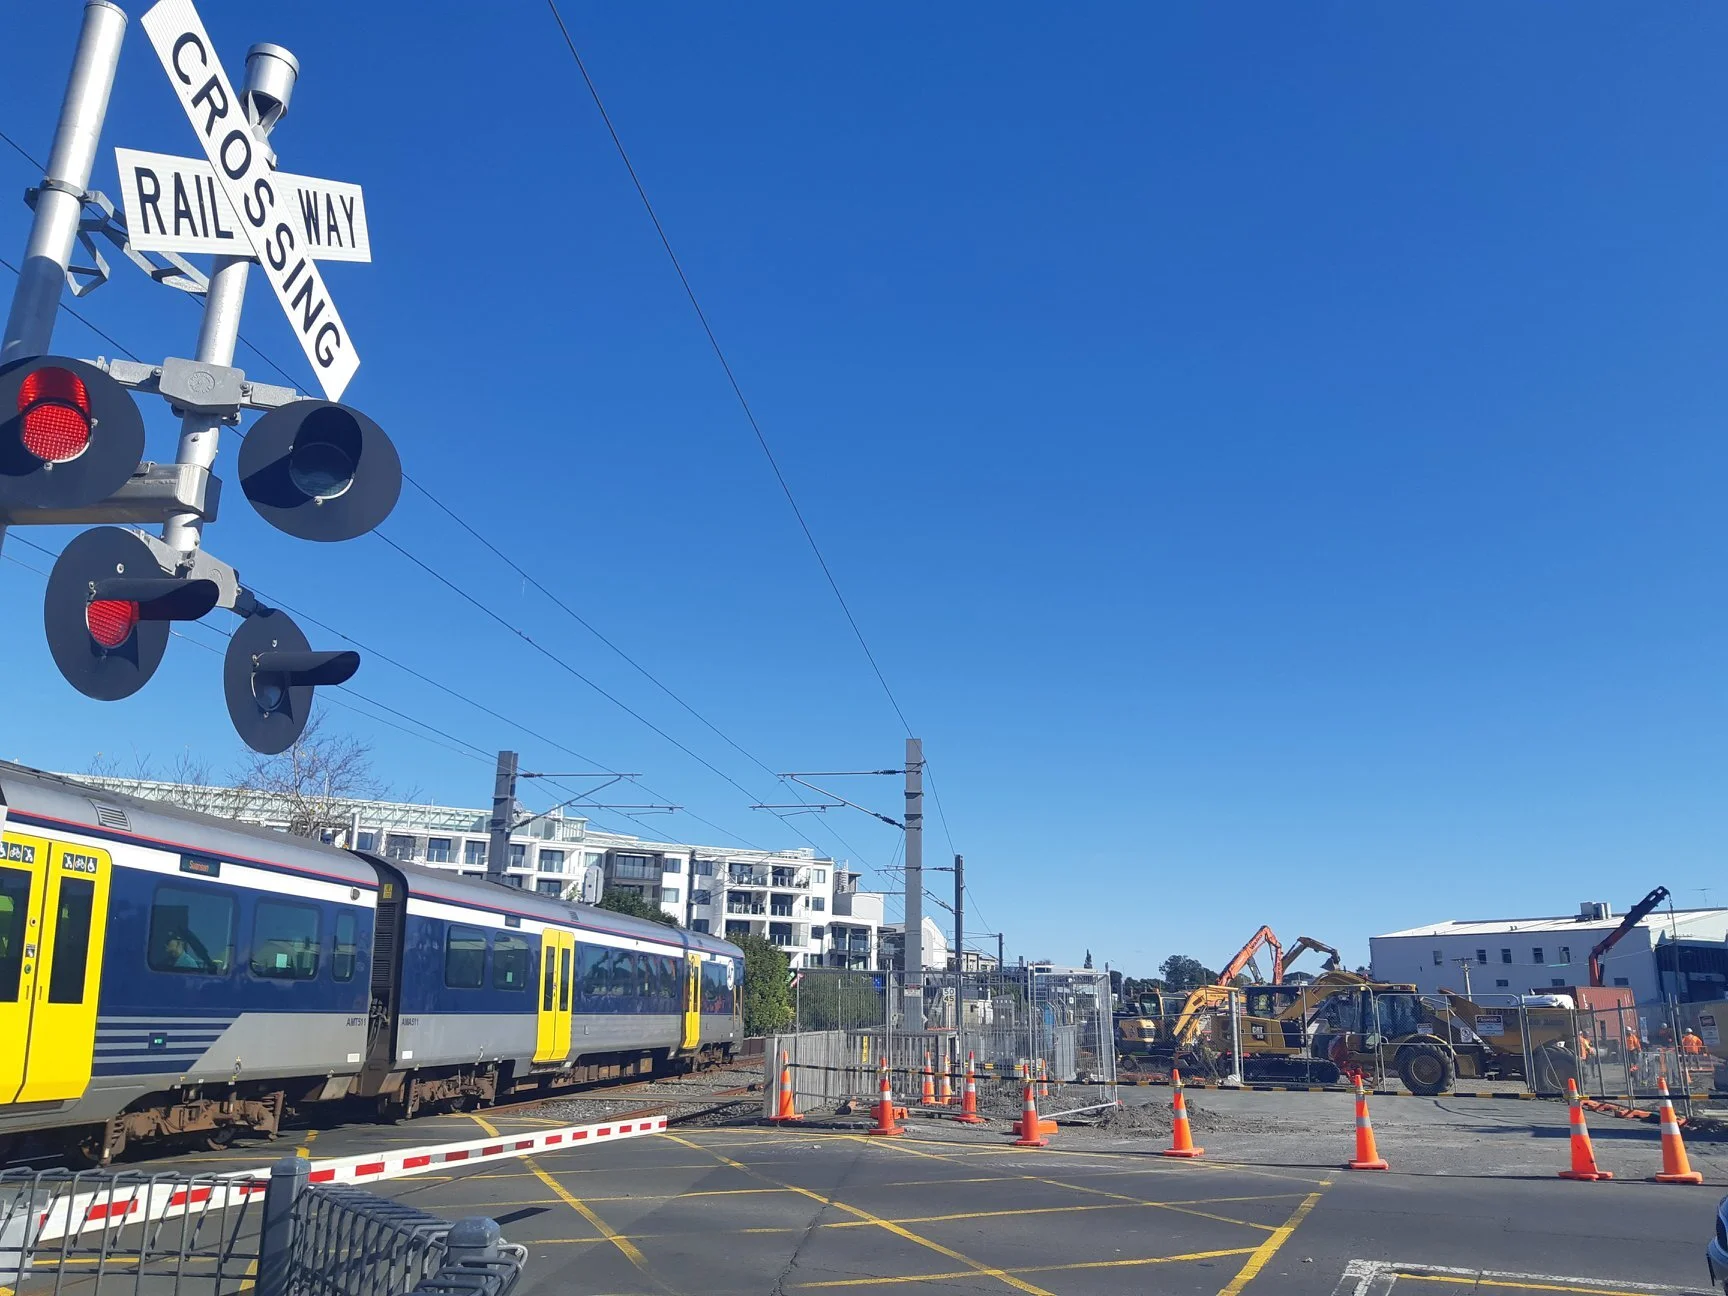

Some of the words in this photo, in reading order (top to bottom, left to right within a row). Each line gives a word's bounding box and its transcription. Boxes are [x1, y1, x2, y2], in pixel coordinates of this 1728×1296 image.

[134, 166, 234, 240] RAIL
[297, 187, 356, 249] WAY
[172, 31, 341, 369] CROSSING
[1252, 1026, 1263, 1034] CAT
